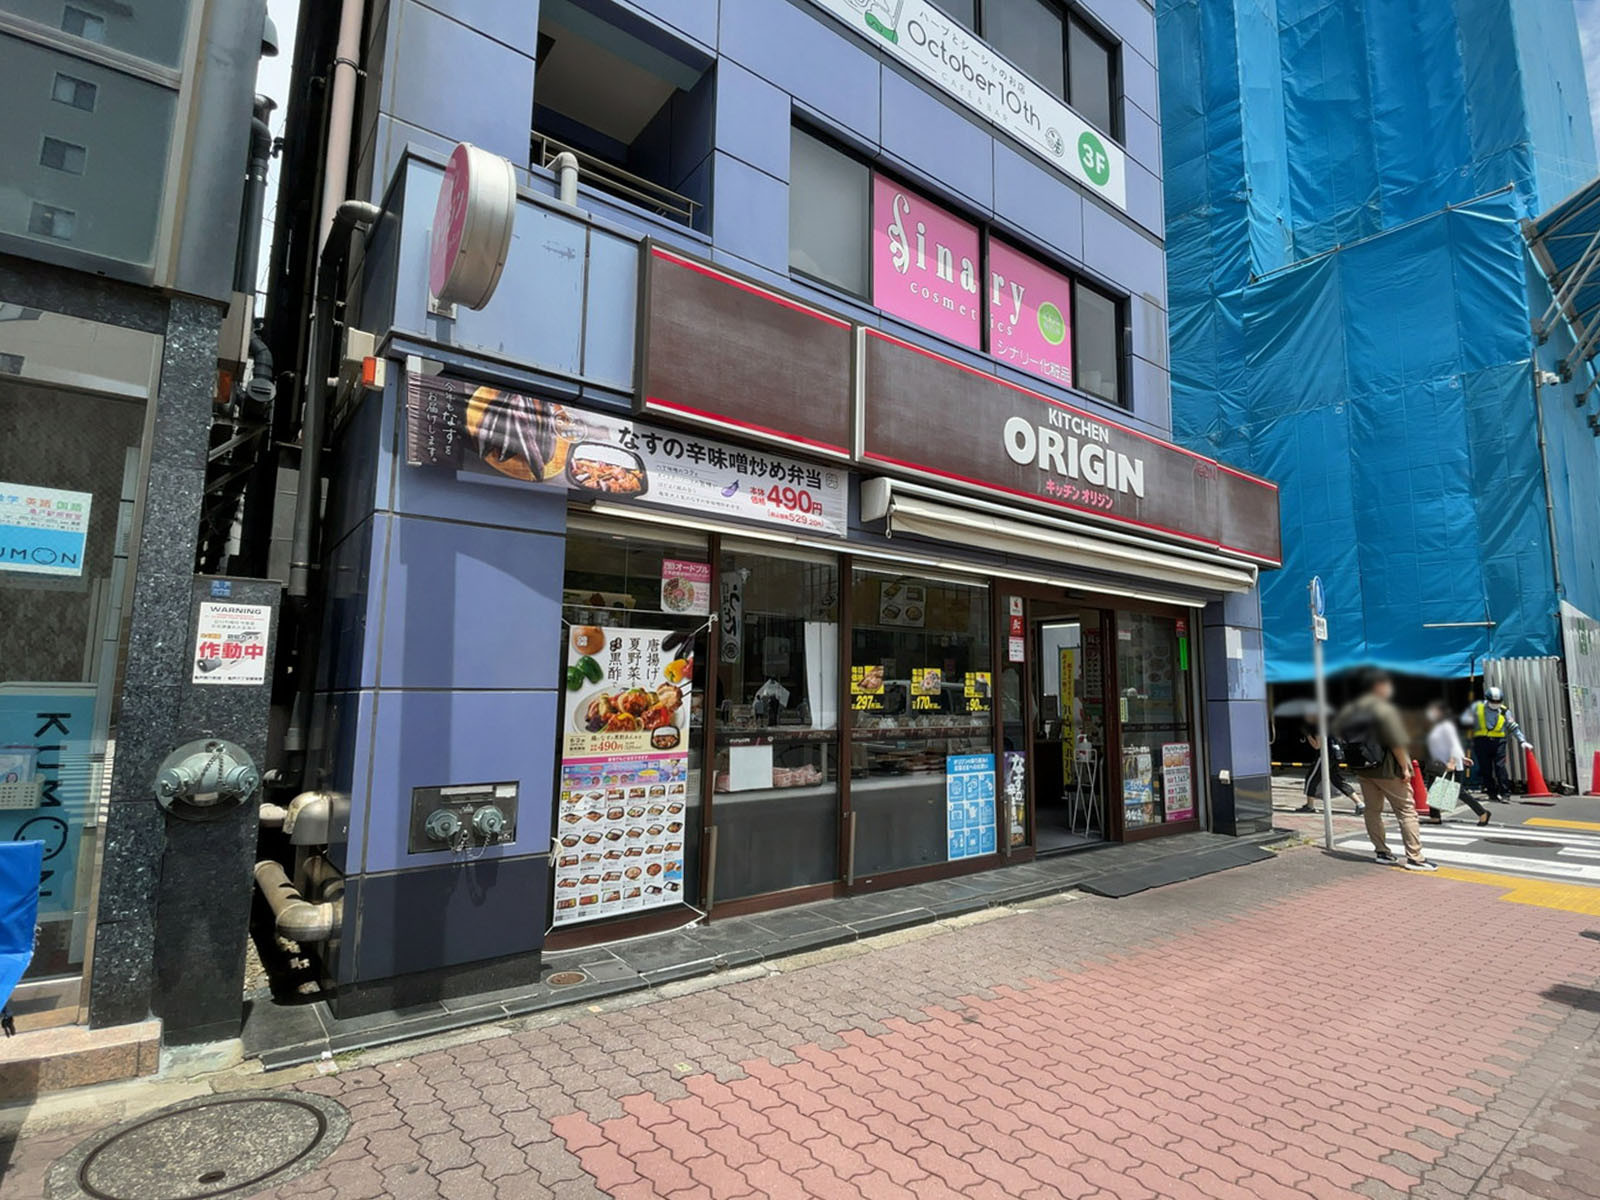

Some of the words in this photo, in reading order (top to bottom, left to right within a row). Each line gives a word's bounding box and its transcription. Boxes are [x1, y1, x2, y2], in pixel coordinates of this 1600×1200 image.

[1081, 143, 1106, 176] 3F
[888, 192, 1026, 325] Sinary
[910, 281, 1013, 336] cosmetics
[1048, 408, 1110, 445] KITCHEN
[618, 426, 823, 491] なすの辛味噌炒め弁当
[1003, 415, 1145, 499] ORIGIN
[767, 484, 823, 517] 490円
[1045, 479, 1080, 500] キッチン
[1083, 490, 1114, 510] オリジン
[210, 606, 262, 615] WARNING
[199, 641, 264, 660] 作動中
